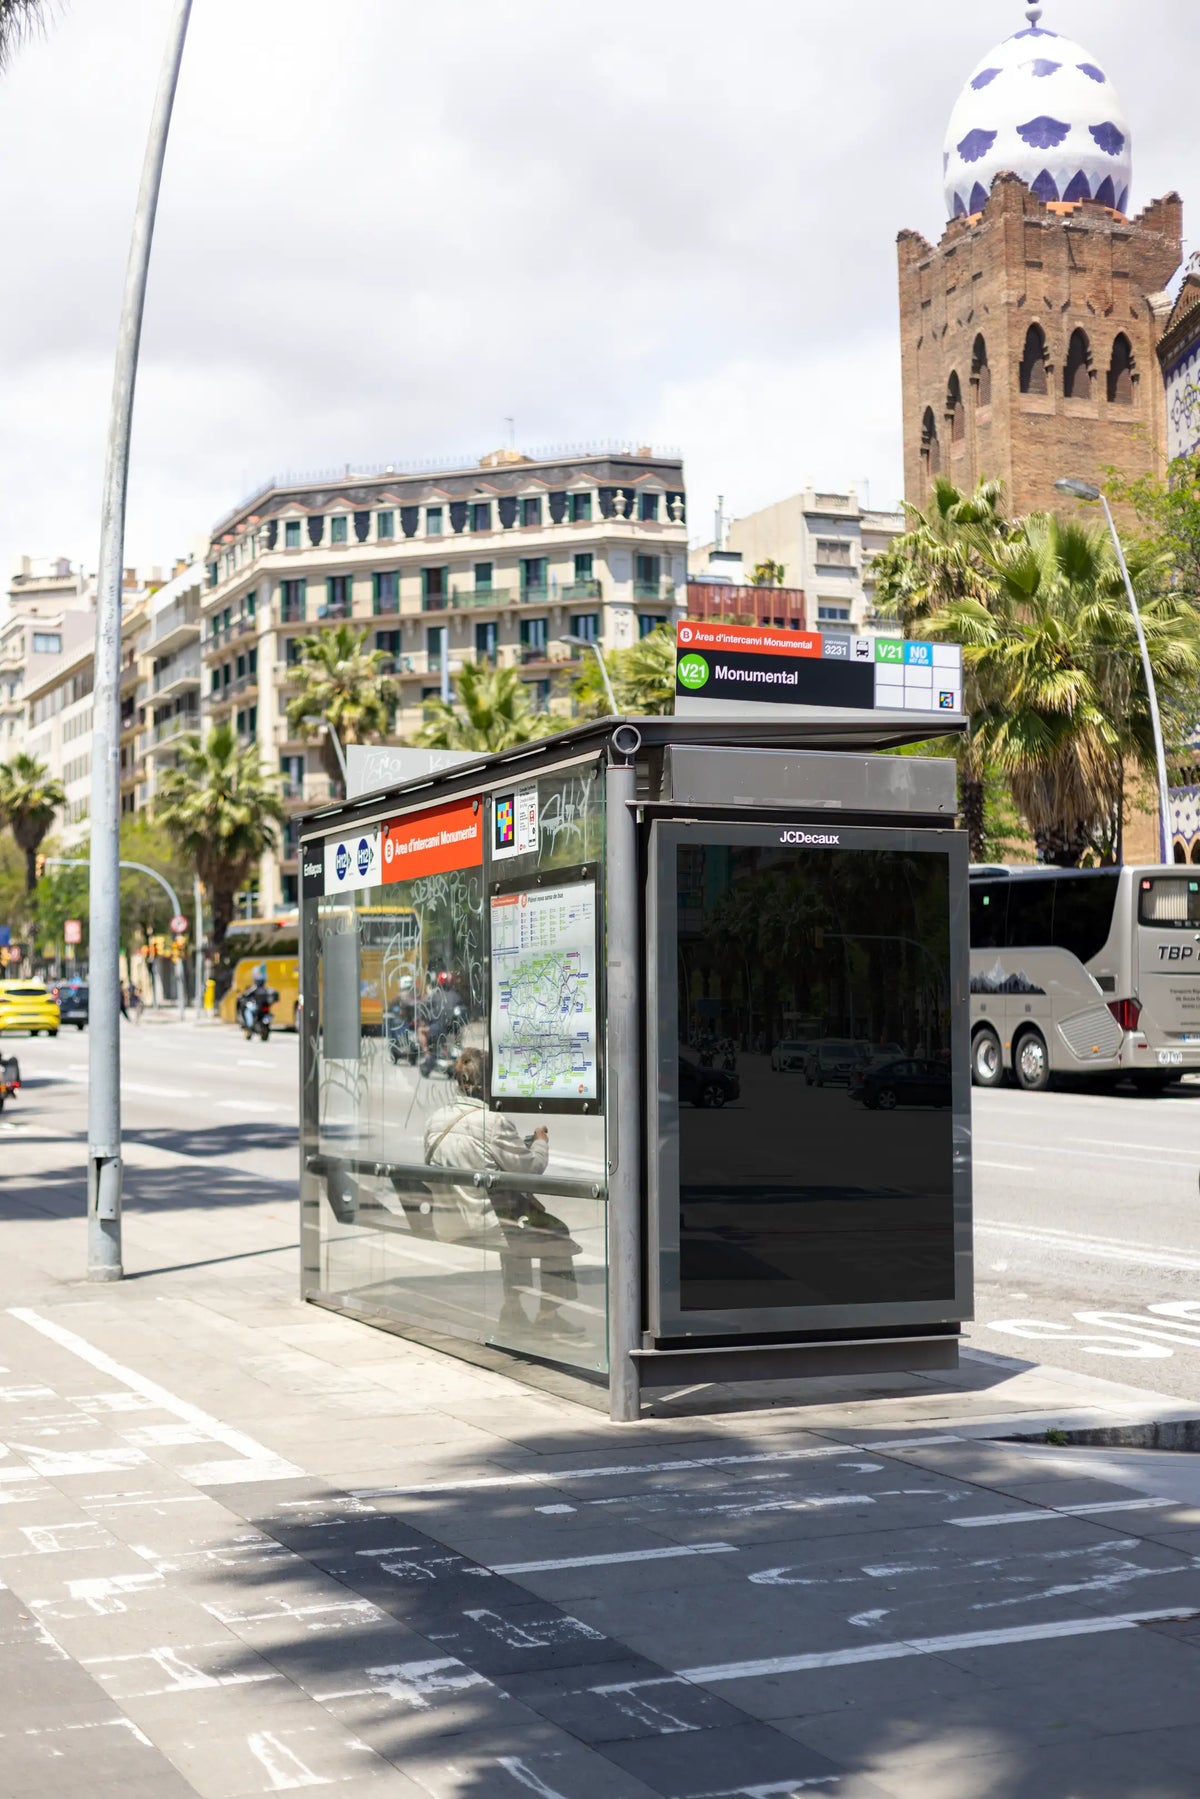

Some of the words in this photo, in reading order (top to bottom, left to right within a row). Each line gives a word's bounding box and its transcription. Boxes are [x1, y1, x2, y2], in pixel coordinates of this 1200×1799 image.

[695, 631, 714, 642] Àrea
[716, 633, 762, 646] d'intercanvi
[763, 637, 813, 650] Monumental
[825, 645, 847, 656] 3231
[878, 644, 902, 659] V21
[680, 663, 705, 679] V21
[715, 665, 798, 685] Monumental
[395, 838, 407, 856] Àrea
[408, 832, 440, 853] d'intercanvi
[441, 823, 477, 846] Monumental
[780, 831, 840, 844] JCDecaux
[1158, 945, 1193, 960] TBP
